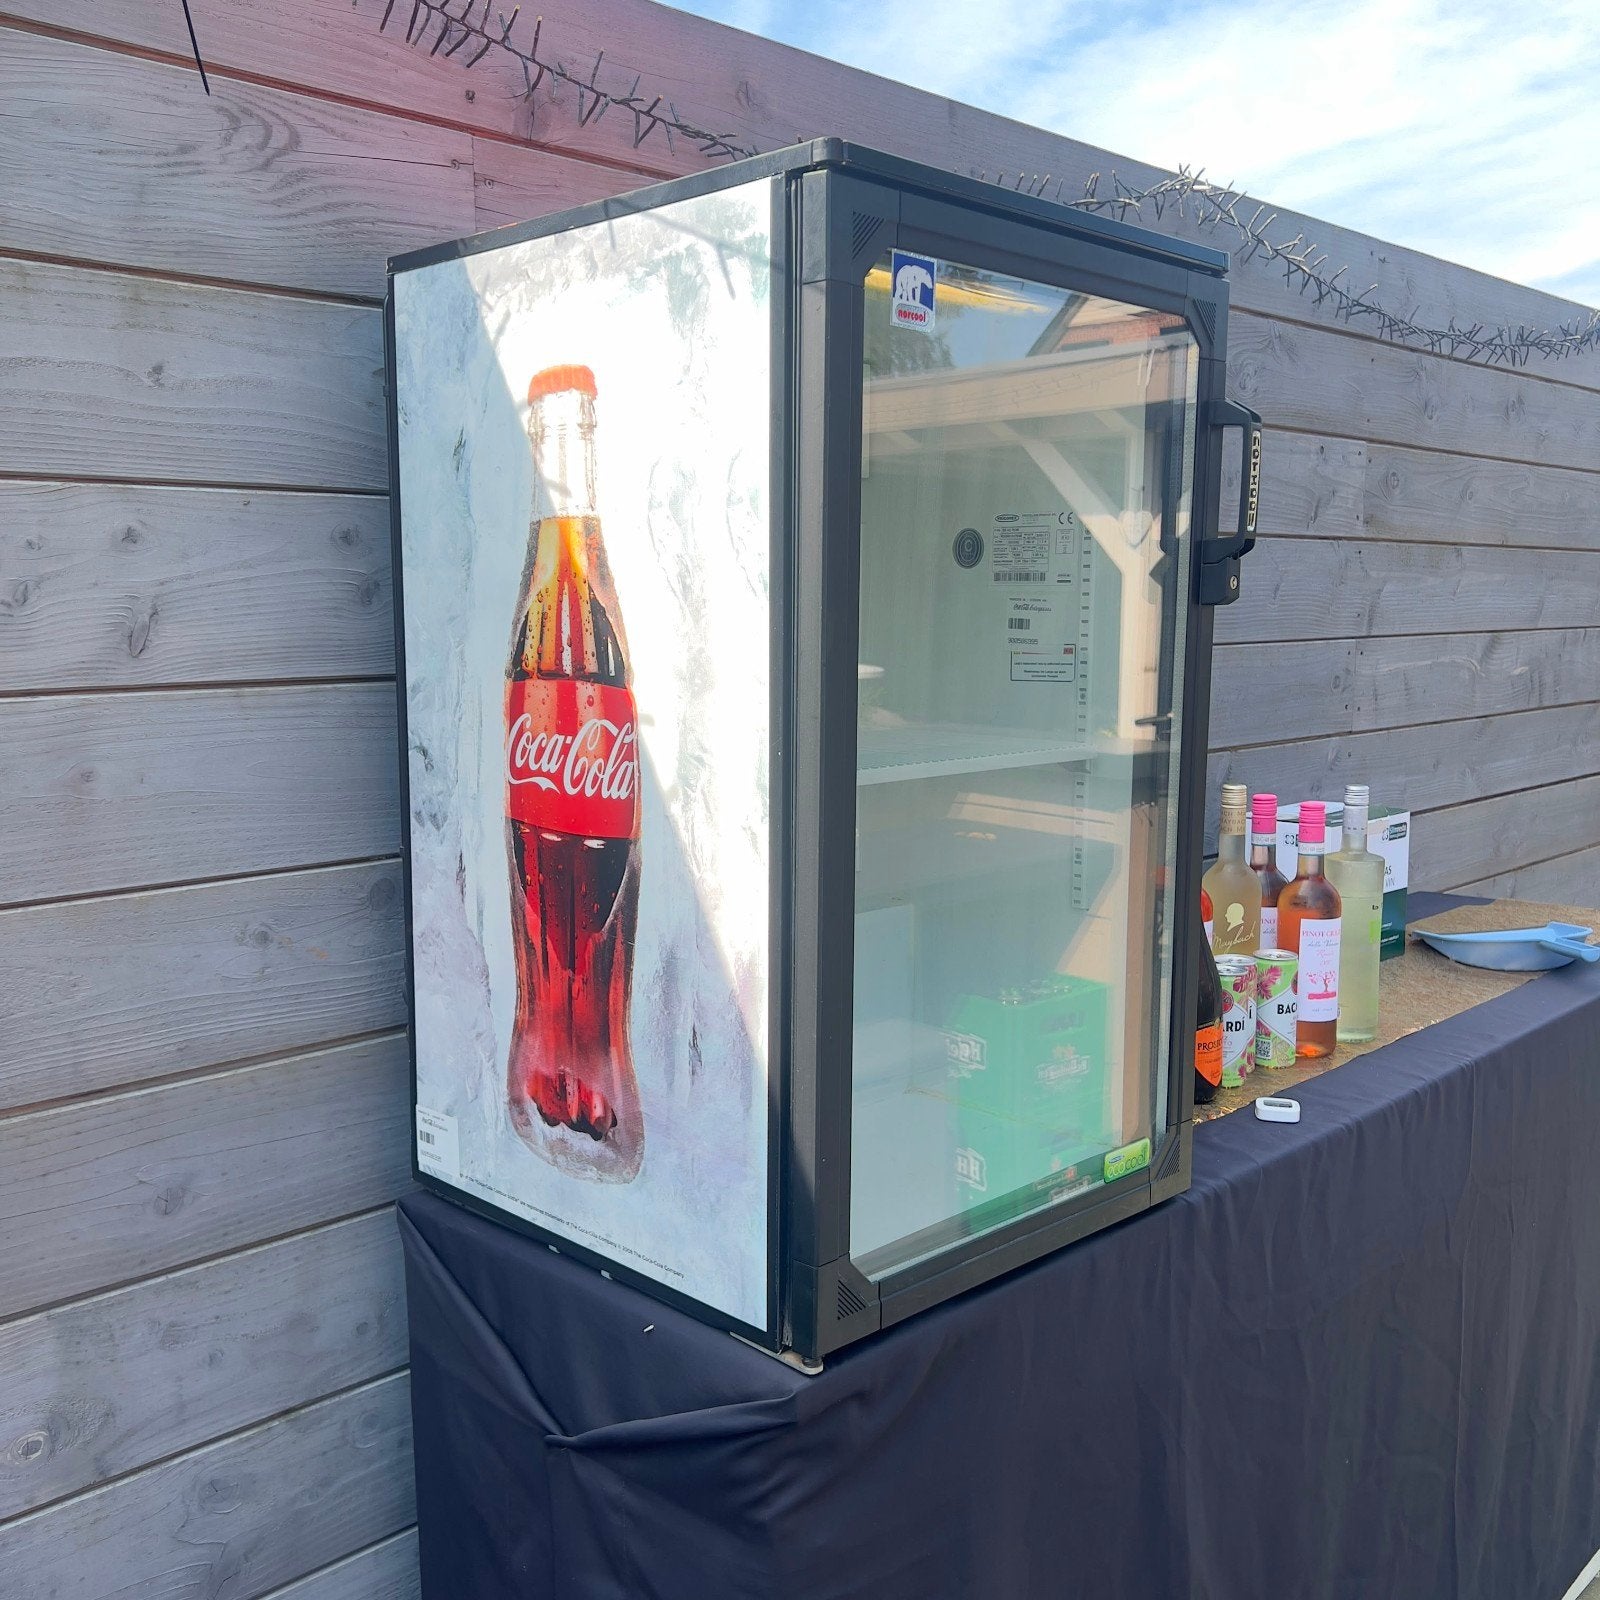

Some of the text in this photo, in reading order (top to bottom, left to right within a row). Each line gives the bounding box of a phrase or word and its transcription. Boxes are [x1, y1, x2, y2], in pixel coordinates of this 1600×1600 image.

[897, 309, 926, 323] norcool
[508, 713, 636, 801] Coca-Cola
[1277, 1002, 1298, 1015] BAC
